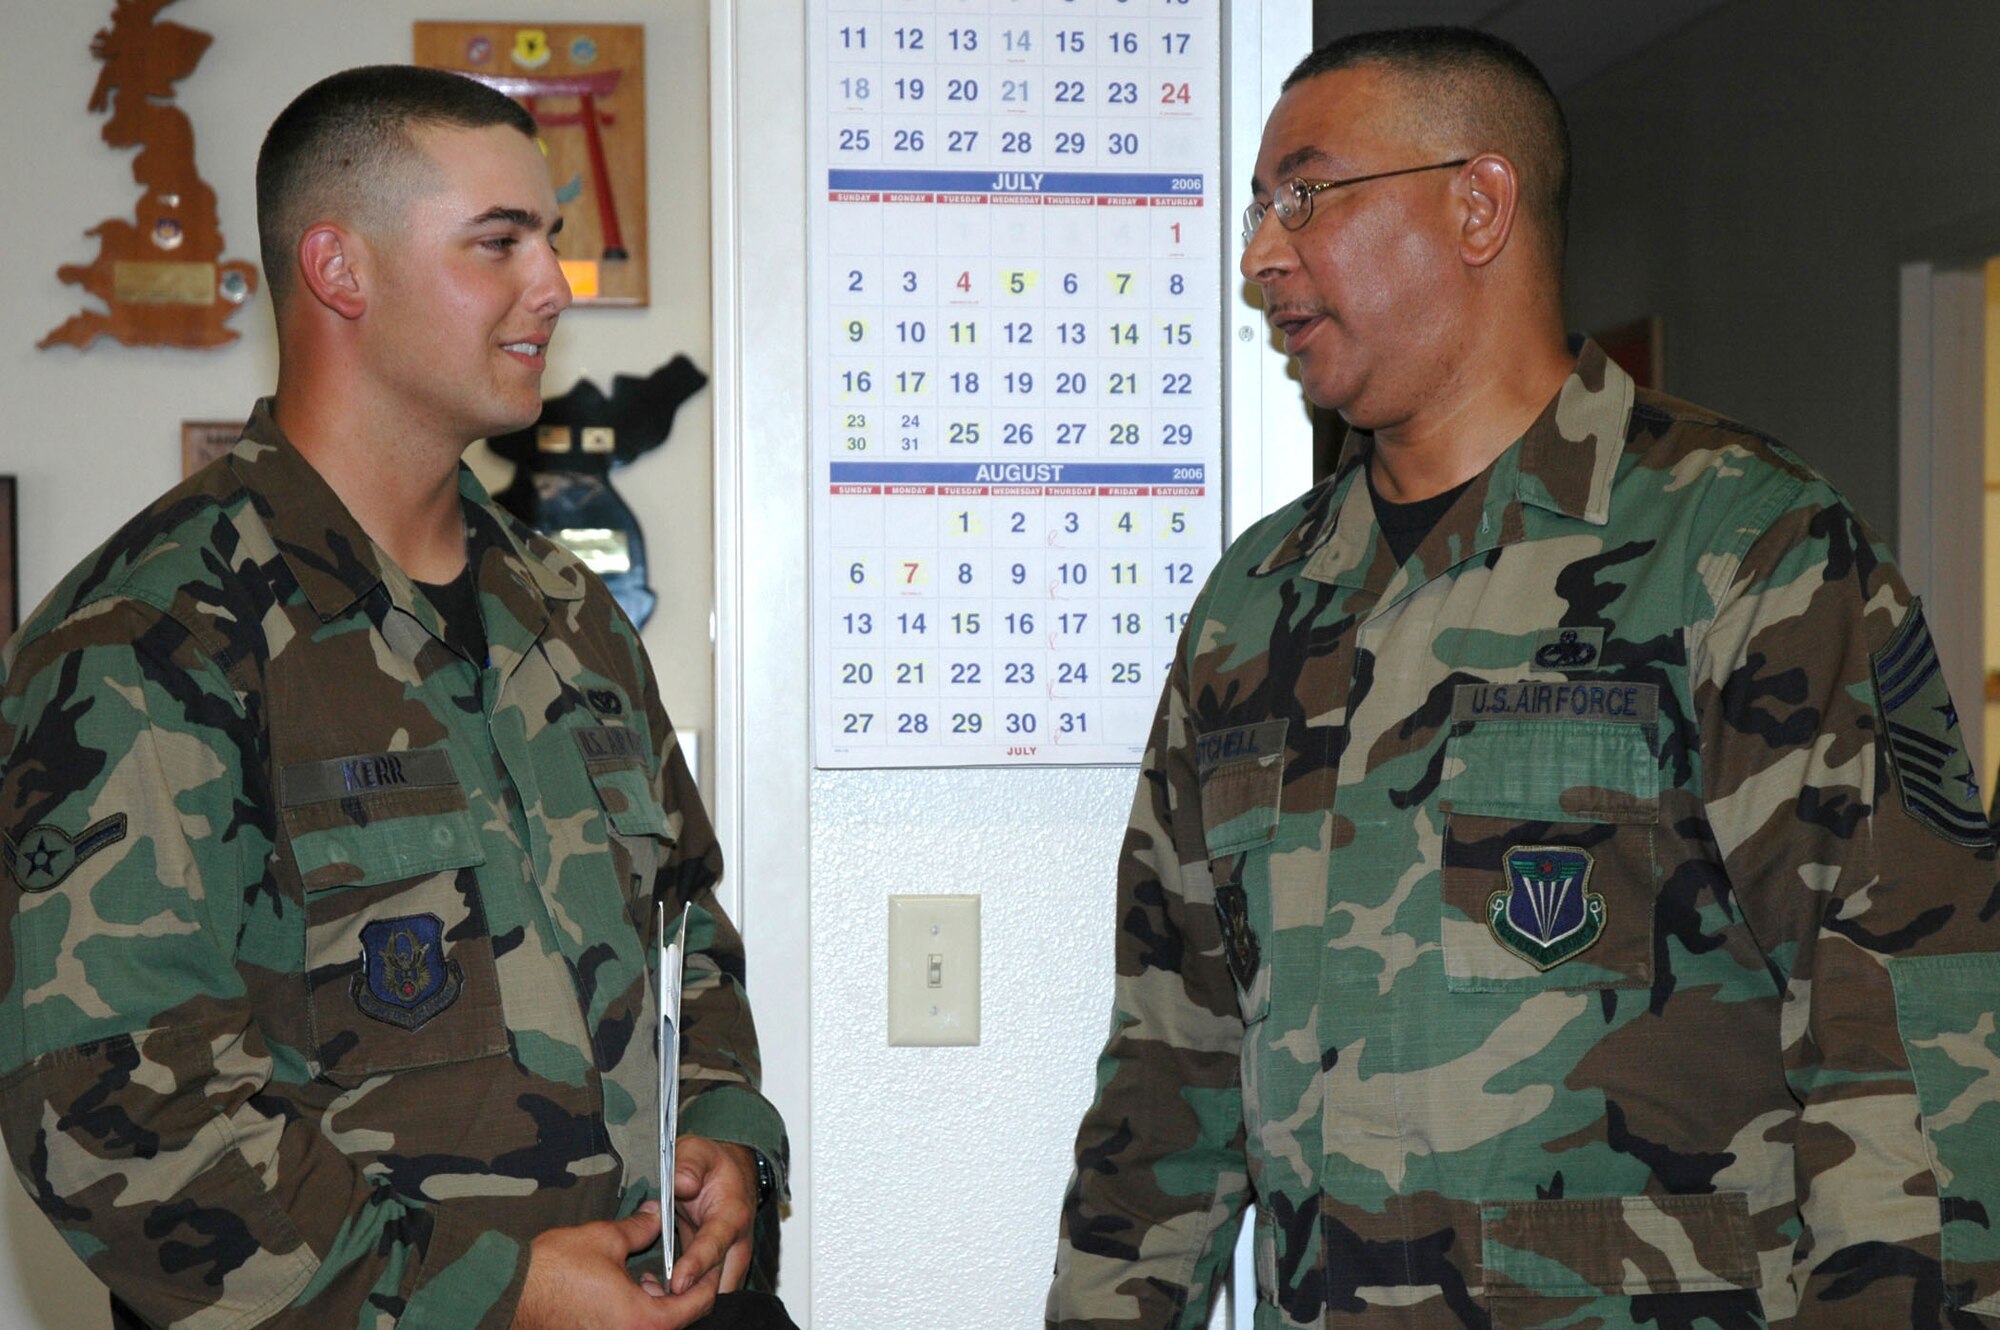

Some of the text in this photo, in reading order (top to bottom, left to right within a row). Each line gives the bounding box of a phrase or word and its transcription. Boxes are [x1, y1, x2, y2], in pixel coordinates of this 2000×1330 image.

[839, 26, 1191, 55] 11 12 13 14 15 16 17
[840, 77, 1191, 105] 18 19 20 21 22 23 24
[839, 128, 1139, 155] 25 26 27 28 29 30
[992, 173, 1202, 190] JULY 2006
[838, 193, 1198, 207] SUNDAY MONDAY TUESDAY WEDNESDAY THURSDAY FRIDAY SATURDAY
[1170, 222, 1181, 244] 1
[848, 270, 1185, 296] 2 3 4 5 6 7 8
[848, 320, 1192, 346] 9 10 11 12 13 14 15
[842, 370, 1192, 395] 16 17 18 19 20 21 22
[847, 413, 921, 429] 23 24
[847, 436, 919, 452] 30 31
[949, 422, 1193, 446] 25 26 27 28 29
[975, 464, 1203, 482] AUGUST 2006
[838, 486, 1200, 497] SUNDAY MONDAY TUESDAY WEDNESDAY THURSDAY FRIDAY SATURDAY
[958, 511, 1186, 534] 1 2 3 4 5
[849, 562, 1194, 585] 6 7 8 9 10 11 12
[843, 612, 873, 635] 13
[897, 612, 927, 635] 14
[951, 612, 981, 635] 15
[1004, 612, 1035, 635] 16
[1058, 612, 1088, 635] 17
[1111, 612, 1141, 635] 18
[842, 662, 1142, 685] 20 21 22 23 24 25
[1555, 685, 1639, 716] FORCE
[843, 712, 1087, 734] 27 28 29 30 31
[1006, 746, 1037, 756] JULY
[341, 756, 408, 791] KERR
